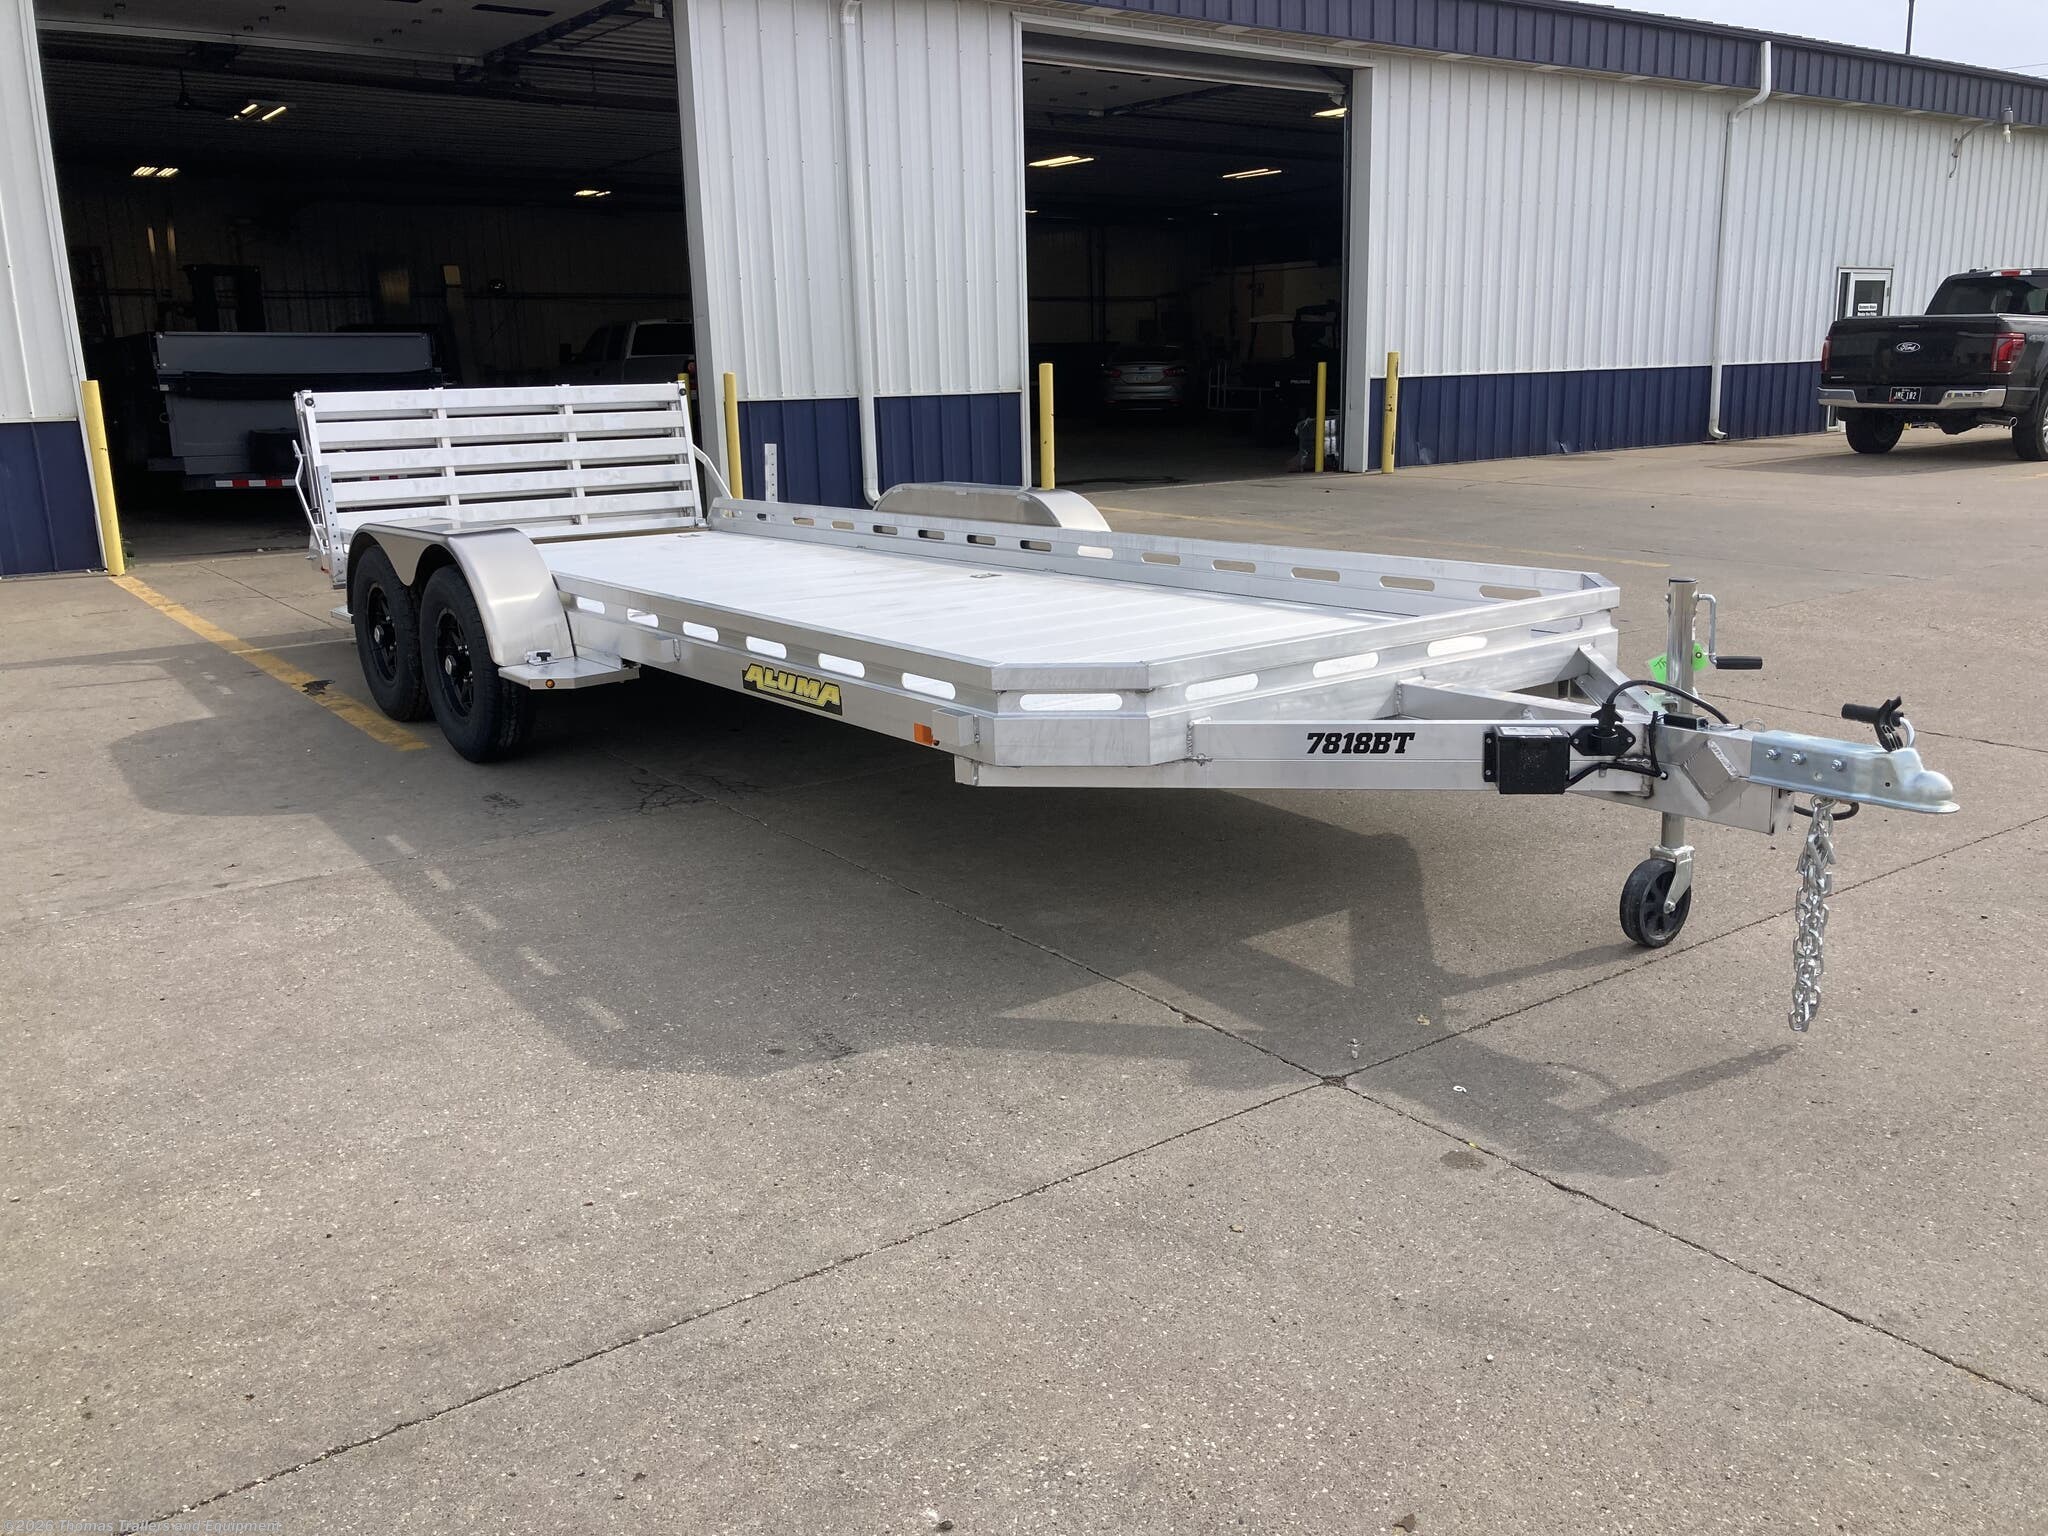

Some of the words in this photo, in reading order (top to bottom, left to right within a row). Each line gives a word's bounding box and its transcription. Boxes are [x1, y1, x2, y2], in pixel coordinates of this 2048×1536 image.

[1898, 342, 1918, 352] Ford
[743, 663, 841, 708] ALUMA
[1306, 732, 1416, 754] 7818BT
